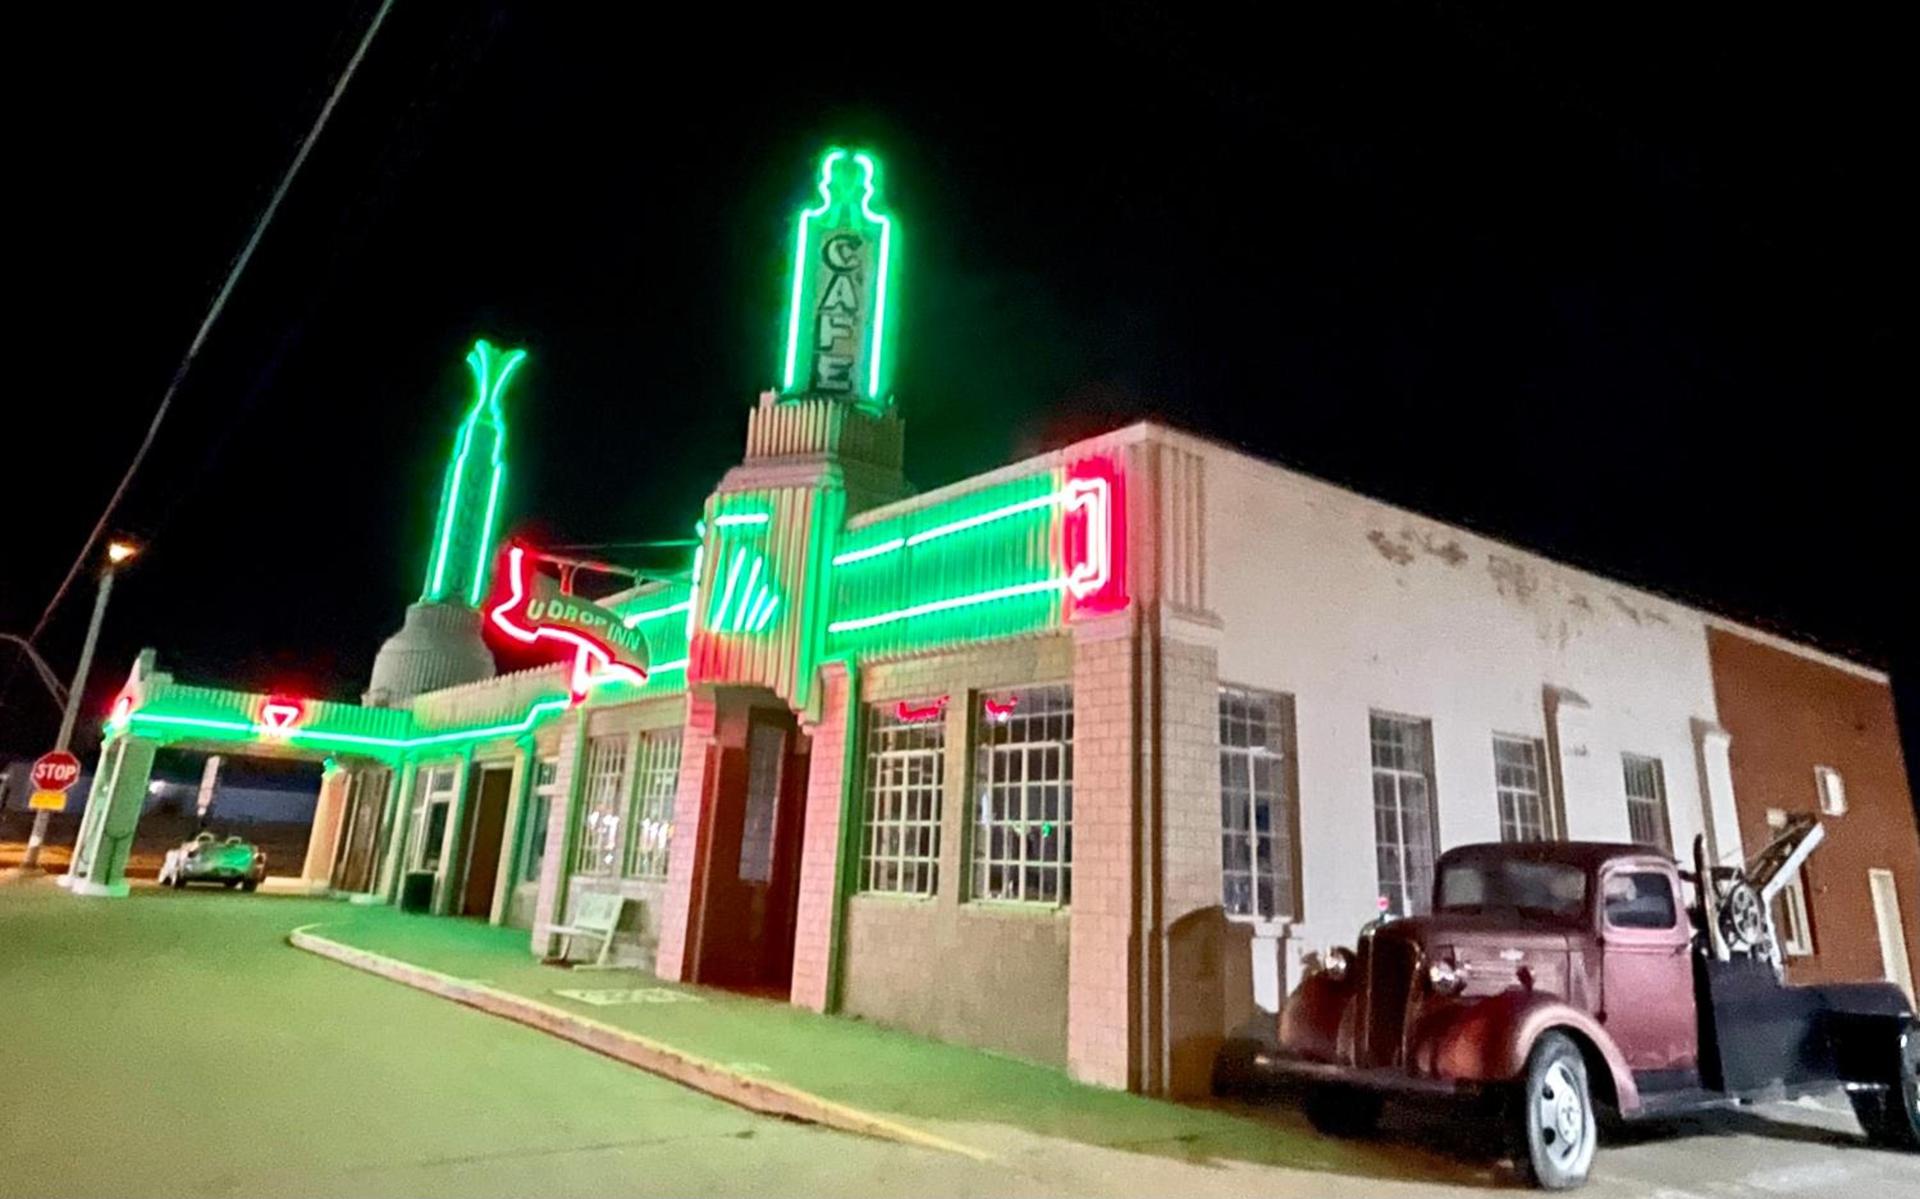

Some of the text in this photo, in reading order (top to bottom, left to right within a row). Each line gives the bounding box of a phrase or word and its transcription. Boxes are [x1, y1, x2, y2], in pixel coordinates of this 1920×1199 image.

[812, 233, 863, 392] CAFE
[526, 598, 641, 651] U DROP INN
[35, 763, 76, 780] STOP
